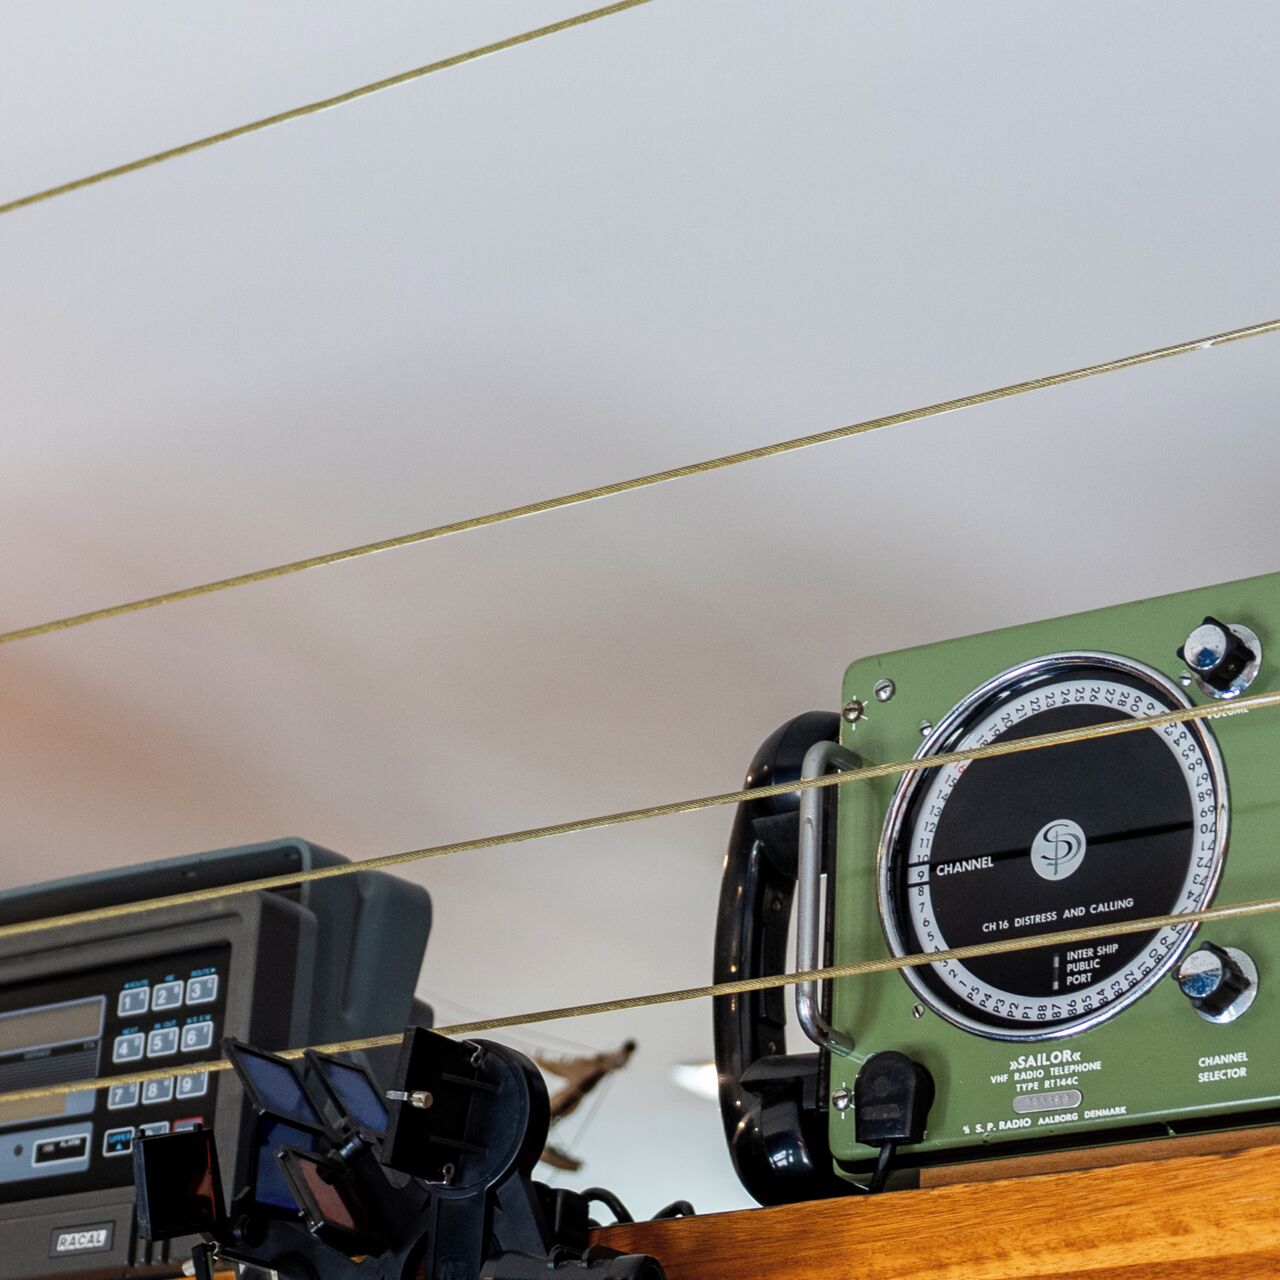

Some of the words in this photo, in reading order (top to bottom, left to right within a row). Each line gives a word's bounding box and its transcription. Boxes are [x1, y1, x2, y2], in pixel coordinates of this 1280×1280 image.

[1045, 692, 1056, 708] 23
[1060, 689, 1070, 705] 24
[1075, 687, 1085, 702] 25
[1089, 686, 1100, 703] 26
[1104, 688, 1116, 704] 27
[1117, 692, 1130, 707] 28
[1030, 698, 1041, 714] 22
[1130, 695, 1142, 712] 60
[1016, 705, 1027, 719] 21
[1001, 713, 1014, 729] 20
[989, 724, 1001, 736] 19
[1173, 731, 1187, 747] 64
[1182, 744, 1195, 760] 65
[1188, 758, 1203, 773] 66
[945, 775, 958, 787] 15
[1196, 773, 1208, 787] 67
[936, 790, 949, 800] 14
[1198, 789, 1212, 802] 68
[929, 805, 942, 817] 13
[1200, 805, 1215, 818] 69
[924, 821, 936, 832] 12
[1200, 824, 1216, 834] 70
[920, 838, 930, 848] 11
[1201, 840, 1215, 851] 71
[936, 856, 994, 876] CHANNEL
[1197, 857, 1212, 868] 72
[918, 871, 924, 880] 9
[1193, 874, 1209, 886] 73
[918, 887, 924, 896] 8
[1186, 890, 1202, 904] 74
[918, 902, 925, 913] 7
[923, 917, 930, 927] 6
[982, 921, 997, 932] CH
[999, 920, 1009, 930] 16
[1014, 912, 1057, 927] DISTRESS
[1063, 906, 1086, 919] AND
[1090, 898, 1134, 914] CALLING
[928, 931, 934, 942] 5
[1160, 935, 1175, 950] 79
[1067, 949, 1094, 961] INTER
[1097, 943, 1118, 956] SHIP
[1149, 948, 1164, 964] 80
[1067, 959, 1101, 973] PUBLIC
[1138, 961, 1151, 976] 81
[949, 969, 958, 979] 2
[1066, 973, 1092, 986] PORT
[1125, 970, 1138, 987] 82
[191, 984, 201, 998] 3
[966, 986, 980, 1001] P5
[1111, 980, 1123, 997] 83
[124, 996, 131, 1009] 1
[158, 990, 167, 1003] 2
[979, 993, 992, 1008] P4
[1082, 995, 1093, 1012] 85
[1096, 988, 1108, 1005] 84
[993, 999, 1005, 1014] P3
[1007, 1002, 1019, 1018] P2
[1022, 1006, 1033, 1019] P1
[1037, 1005, 1047, 1020] 88
[1052, 1004, 1062, 1018] 87
[1068, 1000, 1078, 1016] 86
[153, 1036, 162, 1050] 5
[187, 1031, 196, 1044] 6
[119, 1042, 128, 1054] 4
[1198, 1052, 1248, 1067] CHANNEL
[990, 1074, 1009, 1084] VHF
[1014, 1070, 1044, 1081] RADIO
[1050, 1061, 1102, 1077] TELEPHONE
[1198, 1067, 1247, 1083] SELECTOR
[148, 1083, 157, 1097] 8
[182, 1078, 192, 1092] 9
[1016, 1083, 1039, 1092] TYPE
[114, 1089, 122, 1103] 7
[999, 1118, 1031, 1130] RADIO
[1038, 1113, 1078, 1125] AALBORG
[1084, 1106, 1127, 1118] DENMARK
[58, 1231, 106, 1250] RACAL
